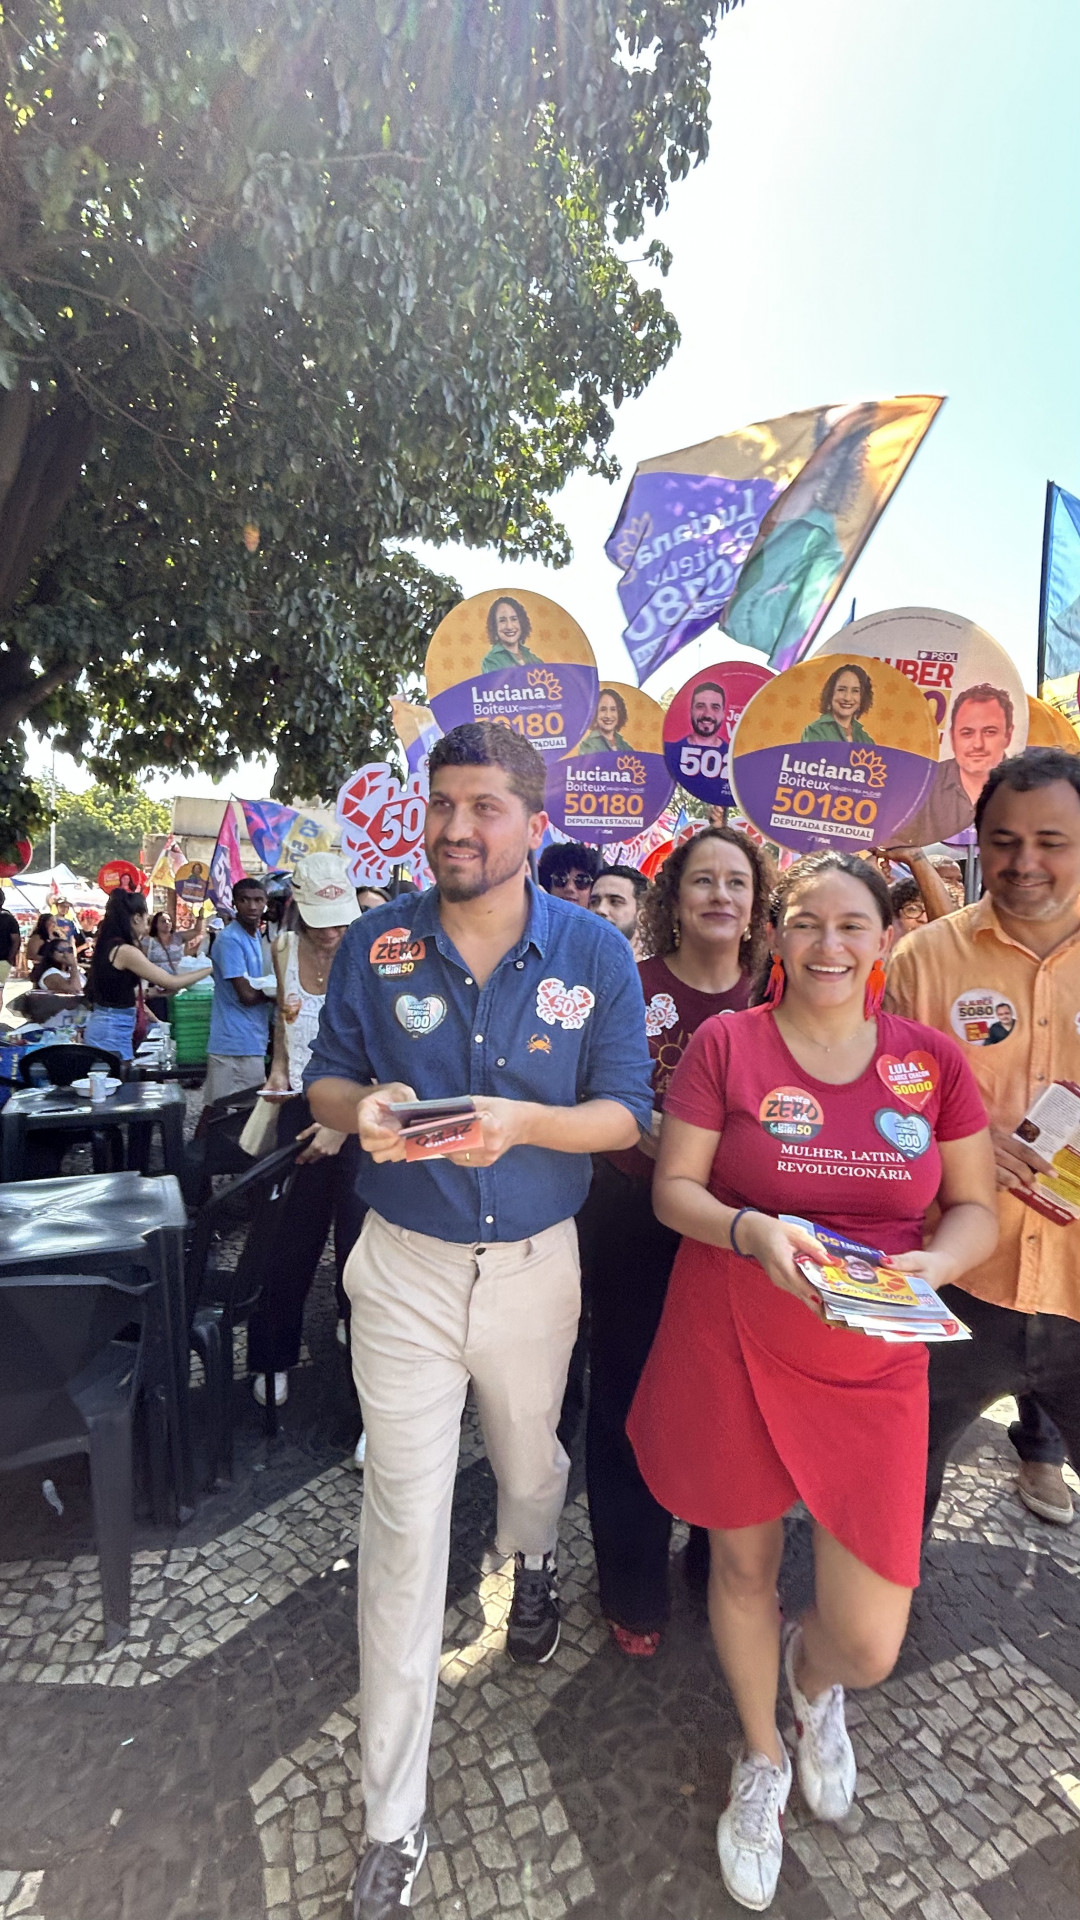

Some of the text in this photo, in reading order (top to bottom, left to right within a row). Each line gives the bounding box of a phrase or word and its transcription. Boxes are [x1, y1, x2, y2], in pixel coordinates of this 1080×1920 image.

[930, 651, 957, 662] PSOL
[471, 684, 546, 703] Luciana
[473, 703, 519, 716] Boiteux
[474, 712, 564, 737] 180
[566, 765, 632, 783] Luciana
[780, 753, 866, 783] Luciana
[565, 780, 607, 792] Boiteux
[779, 771, 830, 791] Boiteux
[563, 792, 644, 816] 50180
[771, 786, 878, 825] 50180
[378, 797, 427, 851] 50
[566, 817, 642, 826] DEPUTADA ESTADUAL
[773, 816, 872, 839] DEPUTADA ESTADUAL
[385, 934, 410, 945] Tarif
[376, 941, 421, 961] ZERO
[400, 961, 415, 974] 50
[551, 999, 575, 1016] 50
[406, 1015, 430, 1029] 500
[888, 1061, 925, 1075] LULA E
[892, 1080, 934, 1095] 50000
[775, 1092, 811, 1105] Tarifa
[765, 1100, 819, 1121] ZERO
[792, 1112, 811, 1123] JÁ
[796, 1124, 812, 1136] 50
[897, 1133, 920, 1148] 500
[780, 1143, 906, 1163] MULHER, LATINA
[776, 1160, 912, 1181] REVOLUCIONÁRIA
